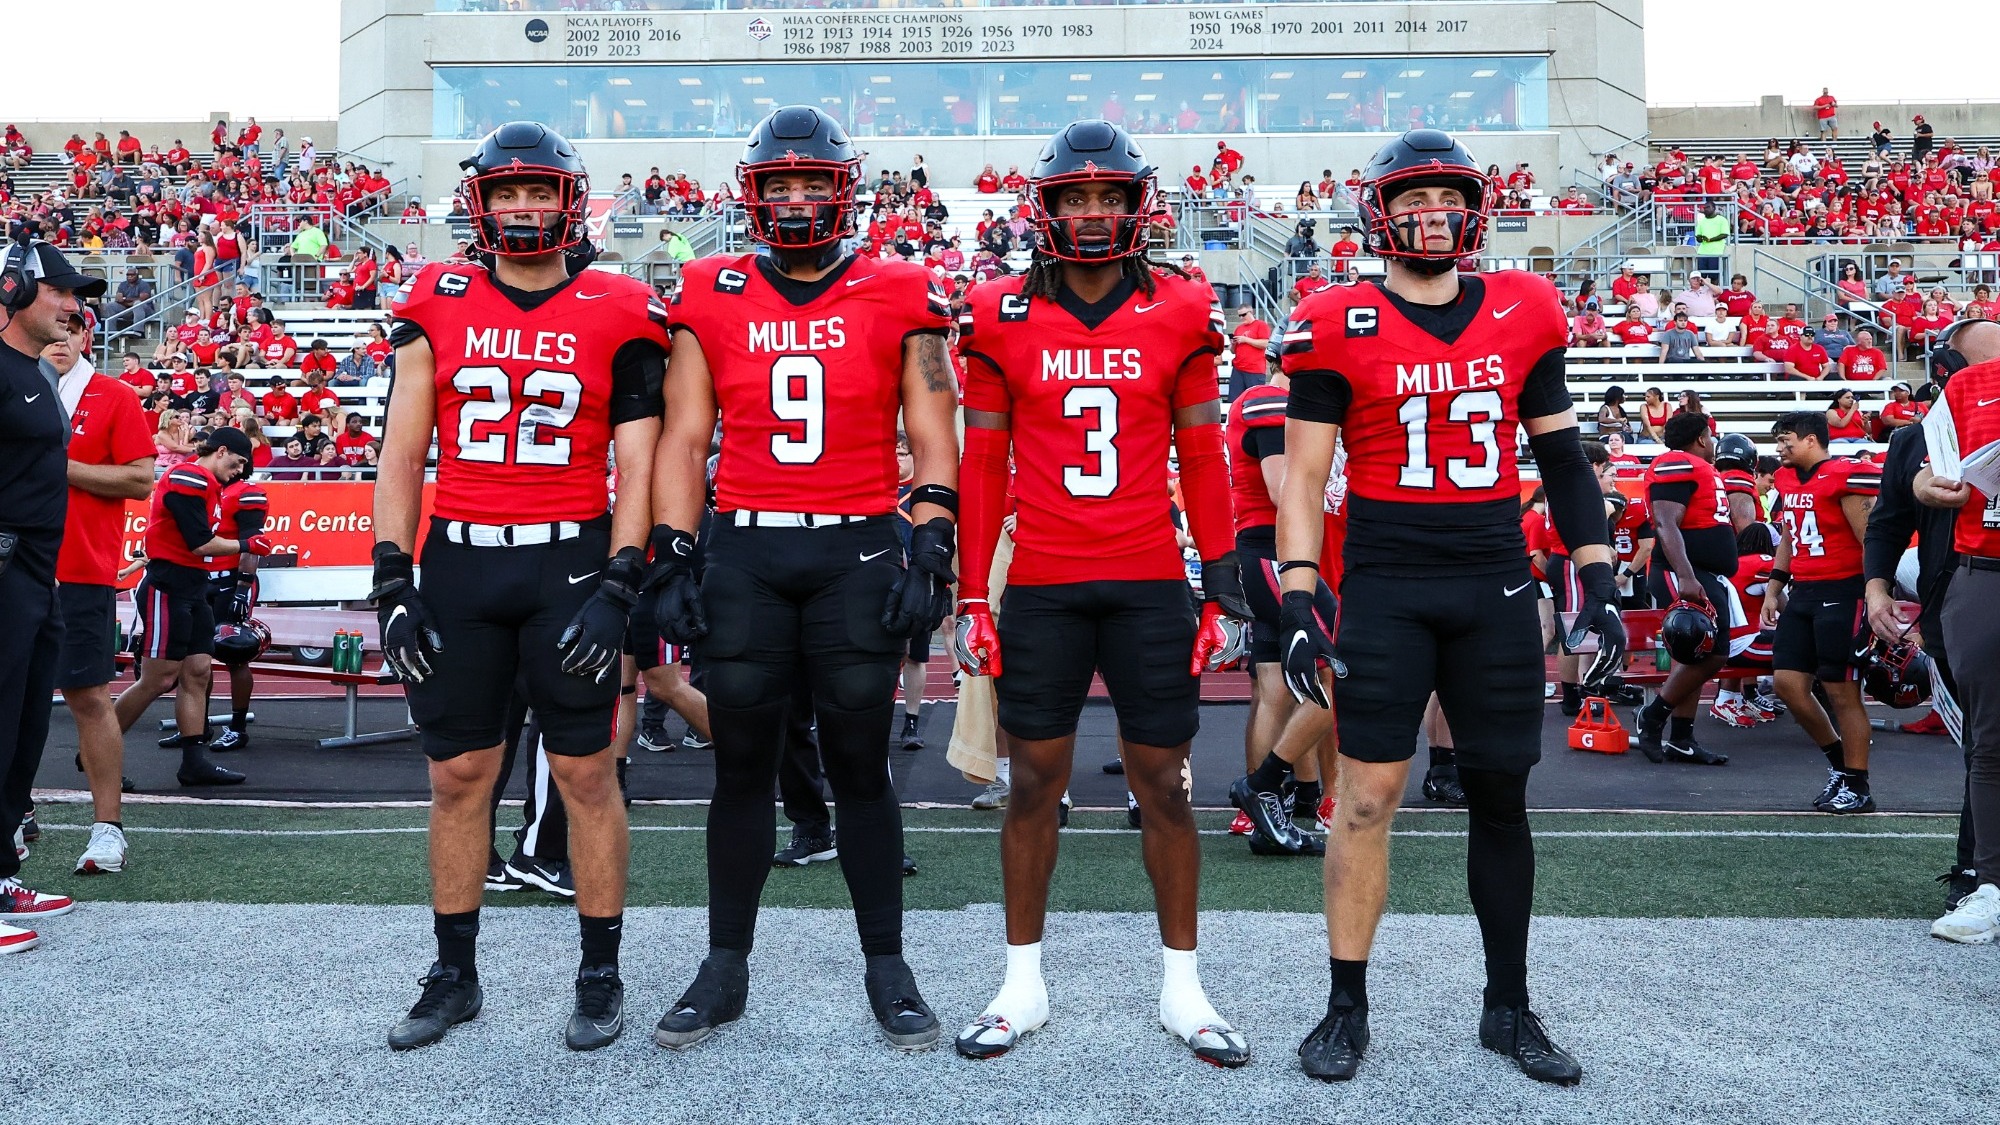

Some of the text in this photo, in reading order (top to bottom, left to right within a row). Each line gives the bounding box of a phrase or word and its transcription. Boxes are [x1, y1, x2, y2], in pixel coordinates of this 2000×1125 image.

[567, 17, 653, 27] NCAA PLAYOFFS
[782, 14, 963, 25] MIAA CONFERENCE CHAMPIONS
[1189, 10, 1264, 20] BOWL GAMES
[566, 29, 681, 42] 2002 2010 2016
[748, 25, 772, 33] MIAA
[783, 24, 1093, 40] 1912 1913 1914 1915 1926 1956 1970 1983
[1190, 20, 1468, 35] 1950 1968 1970 2001 2011 2014 2017
[566, 44, 641, 57] 2019 2023
[783, 40, 1015, 55] 1986 1987 1988 2003 2019 2023
[1189, 37, 1224, 50] 2024
[438, 272, 470, 291] C
[718, 268, 747, 287] C
[1001, 294, 1029, 315] C
[1347, 307, 1377, 330] C
[748, 316, 846, 353] MULES
[464, 326, 577, 365] MULES
[1041, 348, 1142, 382] MULES
[1396, 354, 1505, 395] MULES
[452, 366, 584, 466] 22
[771, 354, 825, 465] 9
[1063, 385, 1119, 498] 3
[1397, 389, 1504, 490] 13
[1783, 493, 1814, 509] MULES
[299, 509, 375, 532] Cente
[1581, 732, 1595, 749] G
